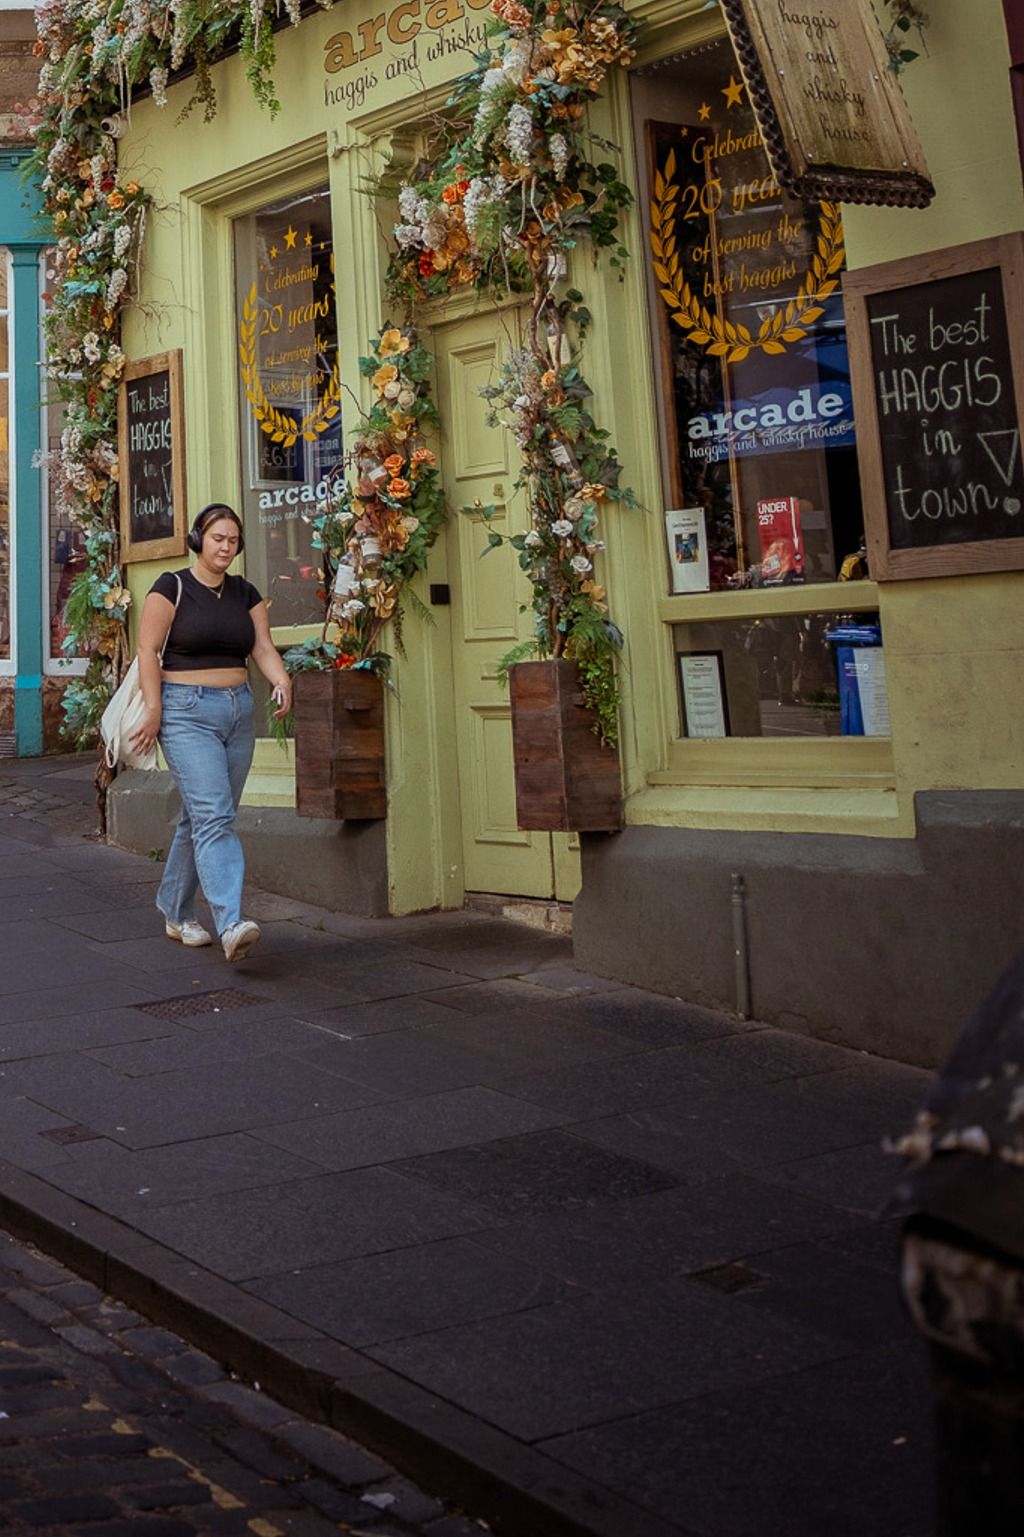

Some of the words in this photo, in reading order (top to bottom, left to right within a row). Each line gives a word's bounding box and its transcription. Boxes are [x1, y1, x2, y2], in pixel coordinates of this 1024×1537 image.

[778, 0, 839, 39] haggis
[324, 67, 379, 111] haggis
[385, 40, 419, 80] and
[427, 17, 489, 61] whisky
[806, 46, 838, 65] and
[803, 76, 865, 117] whisky
[819, 112, 871, 142] house
[681, 178, 723, 221] 20
[692, 233, 711, 264] of
[715, 228, 772, 252] serving
[777, 214, 803, 243] the
[265, 264, 319, 293] Celebrating
[703, 272, 734, 298] best
[739, 260, 797, 293] haggis
[260, 303, 283, 335] 20
[288, 293, 329, 333] years
[870, 314, 917, 356] The
[929, 293, 992, 352] best
[128, 390, 147, 414] The
[149, 380, 169, 411] best
[879, 356, 1002, 415] HAGGIS
[687, 388, 844, 439] arcade
[131, 416, 172, 452] HAGGIS
[689, 441, 730, 464] haggis
[732, 433, 758, 451] and
[762, 429, 805, 449] whisky
[809, 423, 847, 440] house
[921, 419, 962, 456] in
[758, 501, 788, 515] UNDER
[758, 514, 774, 525] 25?
